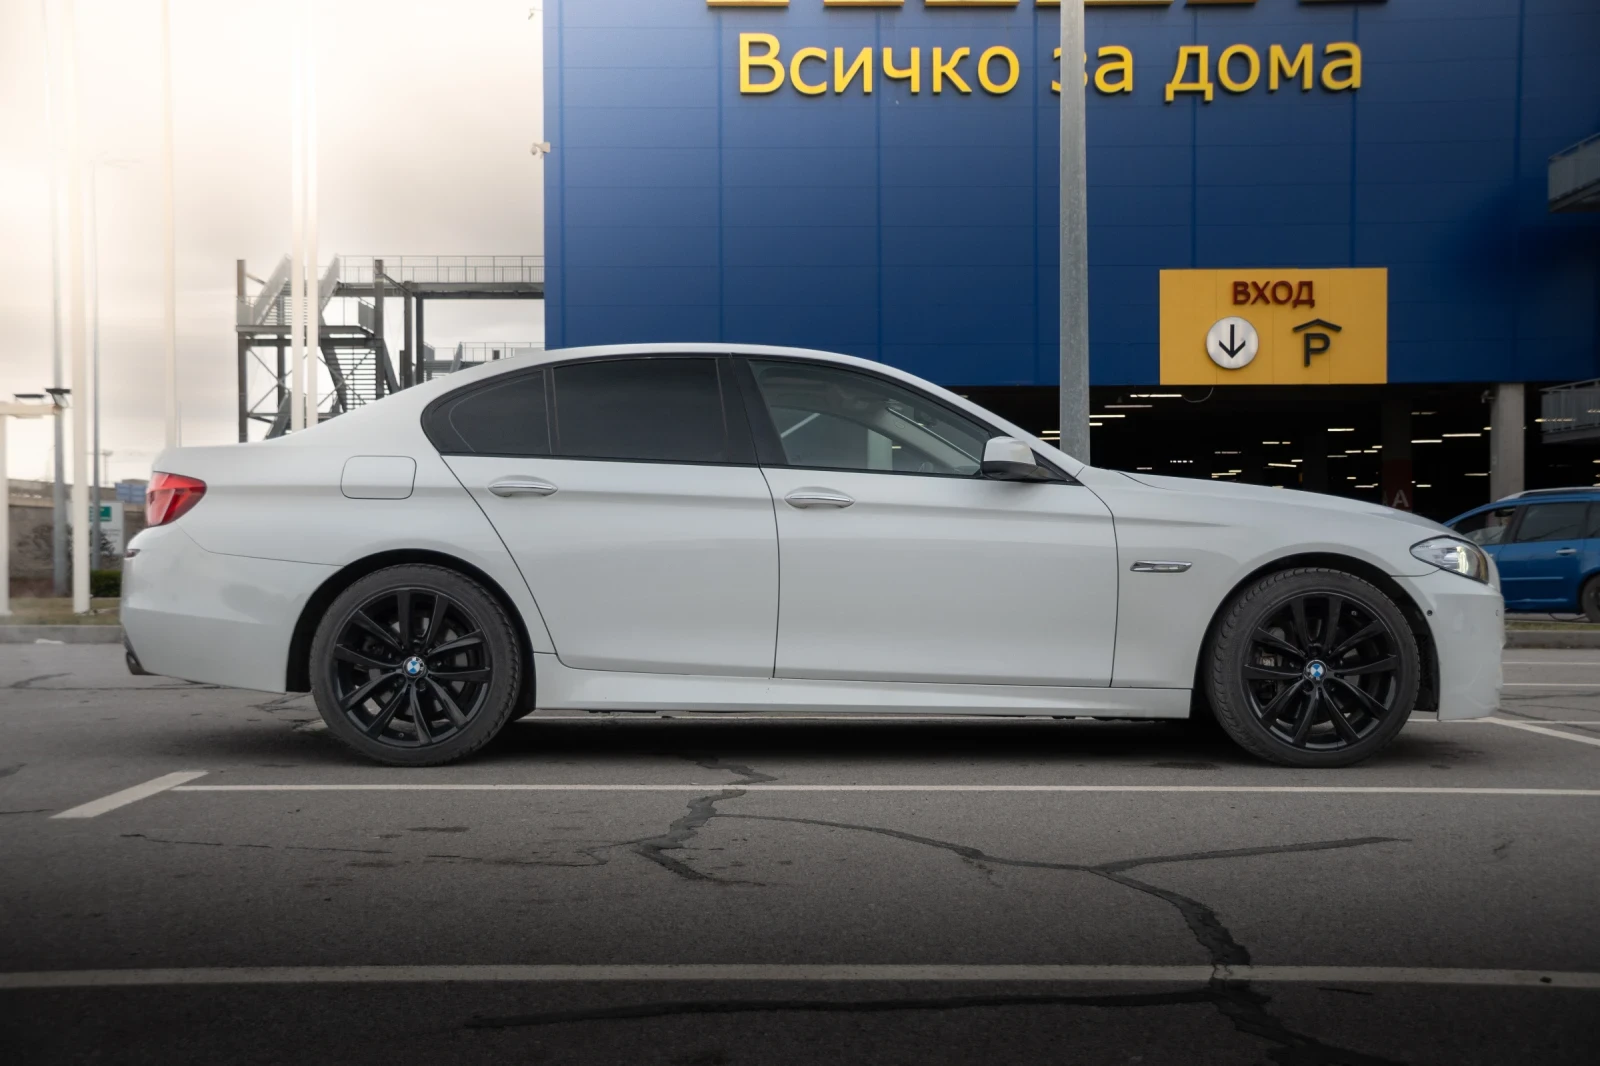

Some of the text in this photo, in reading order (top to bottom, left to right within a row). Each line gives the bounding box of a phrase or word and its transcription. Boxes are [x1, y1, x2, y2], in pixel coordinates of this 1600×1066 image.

[739, 32, 1020, 95] Всичко
[1165, 41, 1362, 102] дома
[1232, 280, 1315, 309] ВХОД
[1303, 332, 1331, 368] P
